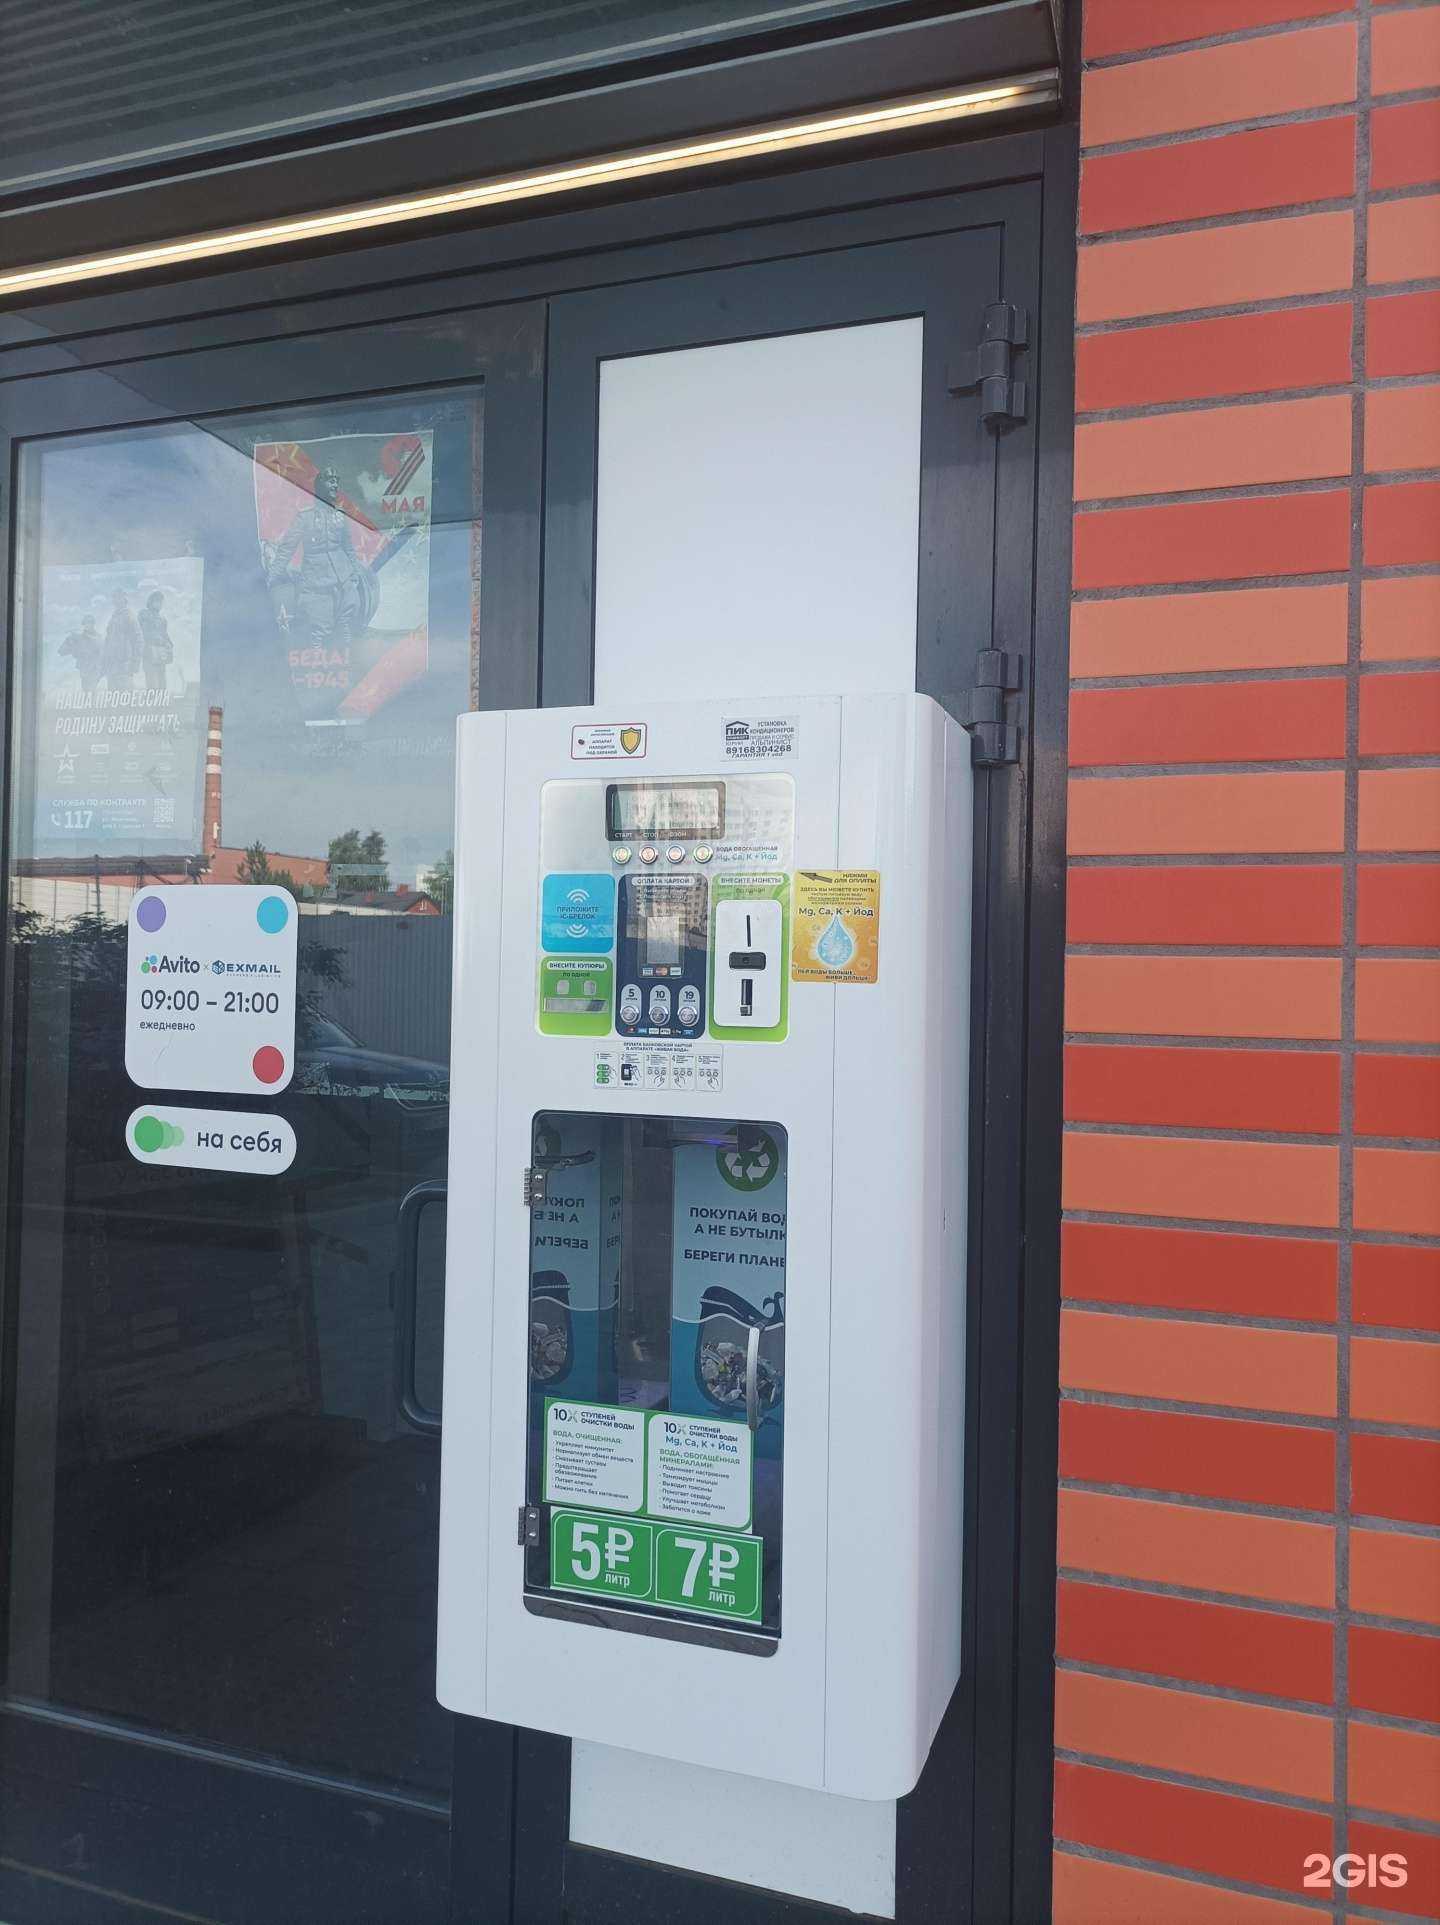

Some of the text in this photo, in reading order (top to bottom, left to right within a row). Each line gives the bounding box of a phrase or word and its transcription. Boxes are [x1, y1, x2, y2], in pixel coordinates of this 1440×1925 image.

[381, 496, 425, 513] МАЯ
[288, 647, 349, 668] БЕДА!
[56, 716, 105, 735] РОДИНУ
[725, 726, 749, 735] ПИК
[726, 744, 792, 754] 89168304268
[64, 810, 93, 829] 117
[798, 907, 816, 916] Mg,
[818, 907, 833, 916] Ca,
[853, 906, 873, 916] Йод
[159, 955, 281, 974] Avito EXMAIL
[628, 988, 635, 997] 5
[655, 990, 665, 998] 10
[684, 991, 694, 999] 19
[141, 989, 200, 1011] 09:00
[223, 991, 279, 1013] 21:00
[140, 1021, 196, 1031] ежедневно
[197, 1131, 282, 1153] на себя
[689, 1206, 757, 1222] ПОКУПАЙ
[694, 1224, 704, 1234] А
[708, 1224, 726, 1235] НЕ
[684, 1249, 735, 1263] БЕРЕГИ
[581, 1411, 616, 1421] СТУПЕНЕЙ
[580, 1418, 635, 1430] ОЧИСТКИ ВОДЫ
[689, 1425, 721, 1434] СТУПЕНЕЙ
[689, 1431, 718, 1440] ОЧИСТКИ
[665, 1436, 682, 1447] Mg,
[684, 1438, 699, 1448] Ca,
[718, 1440, 738, 1453] Йод
[604, 1572, 630, 1588] литр
[708, 1591, 736, 1606] литр
